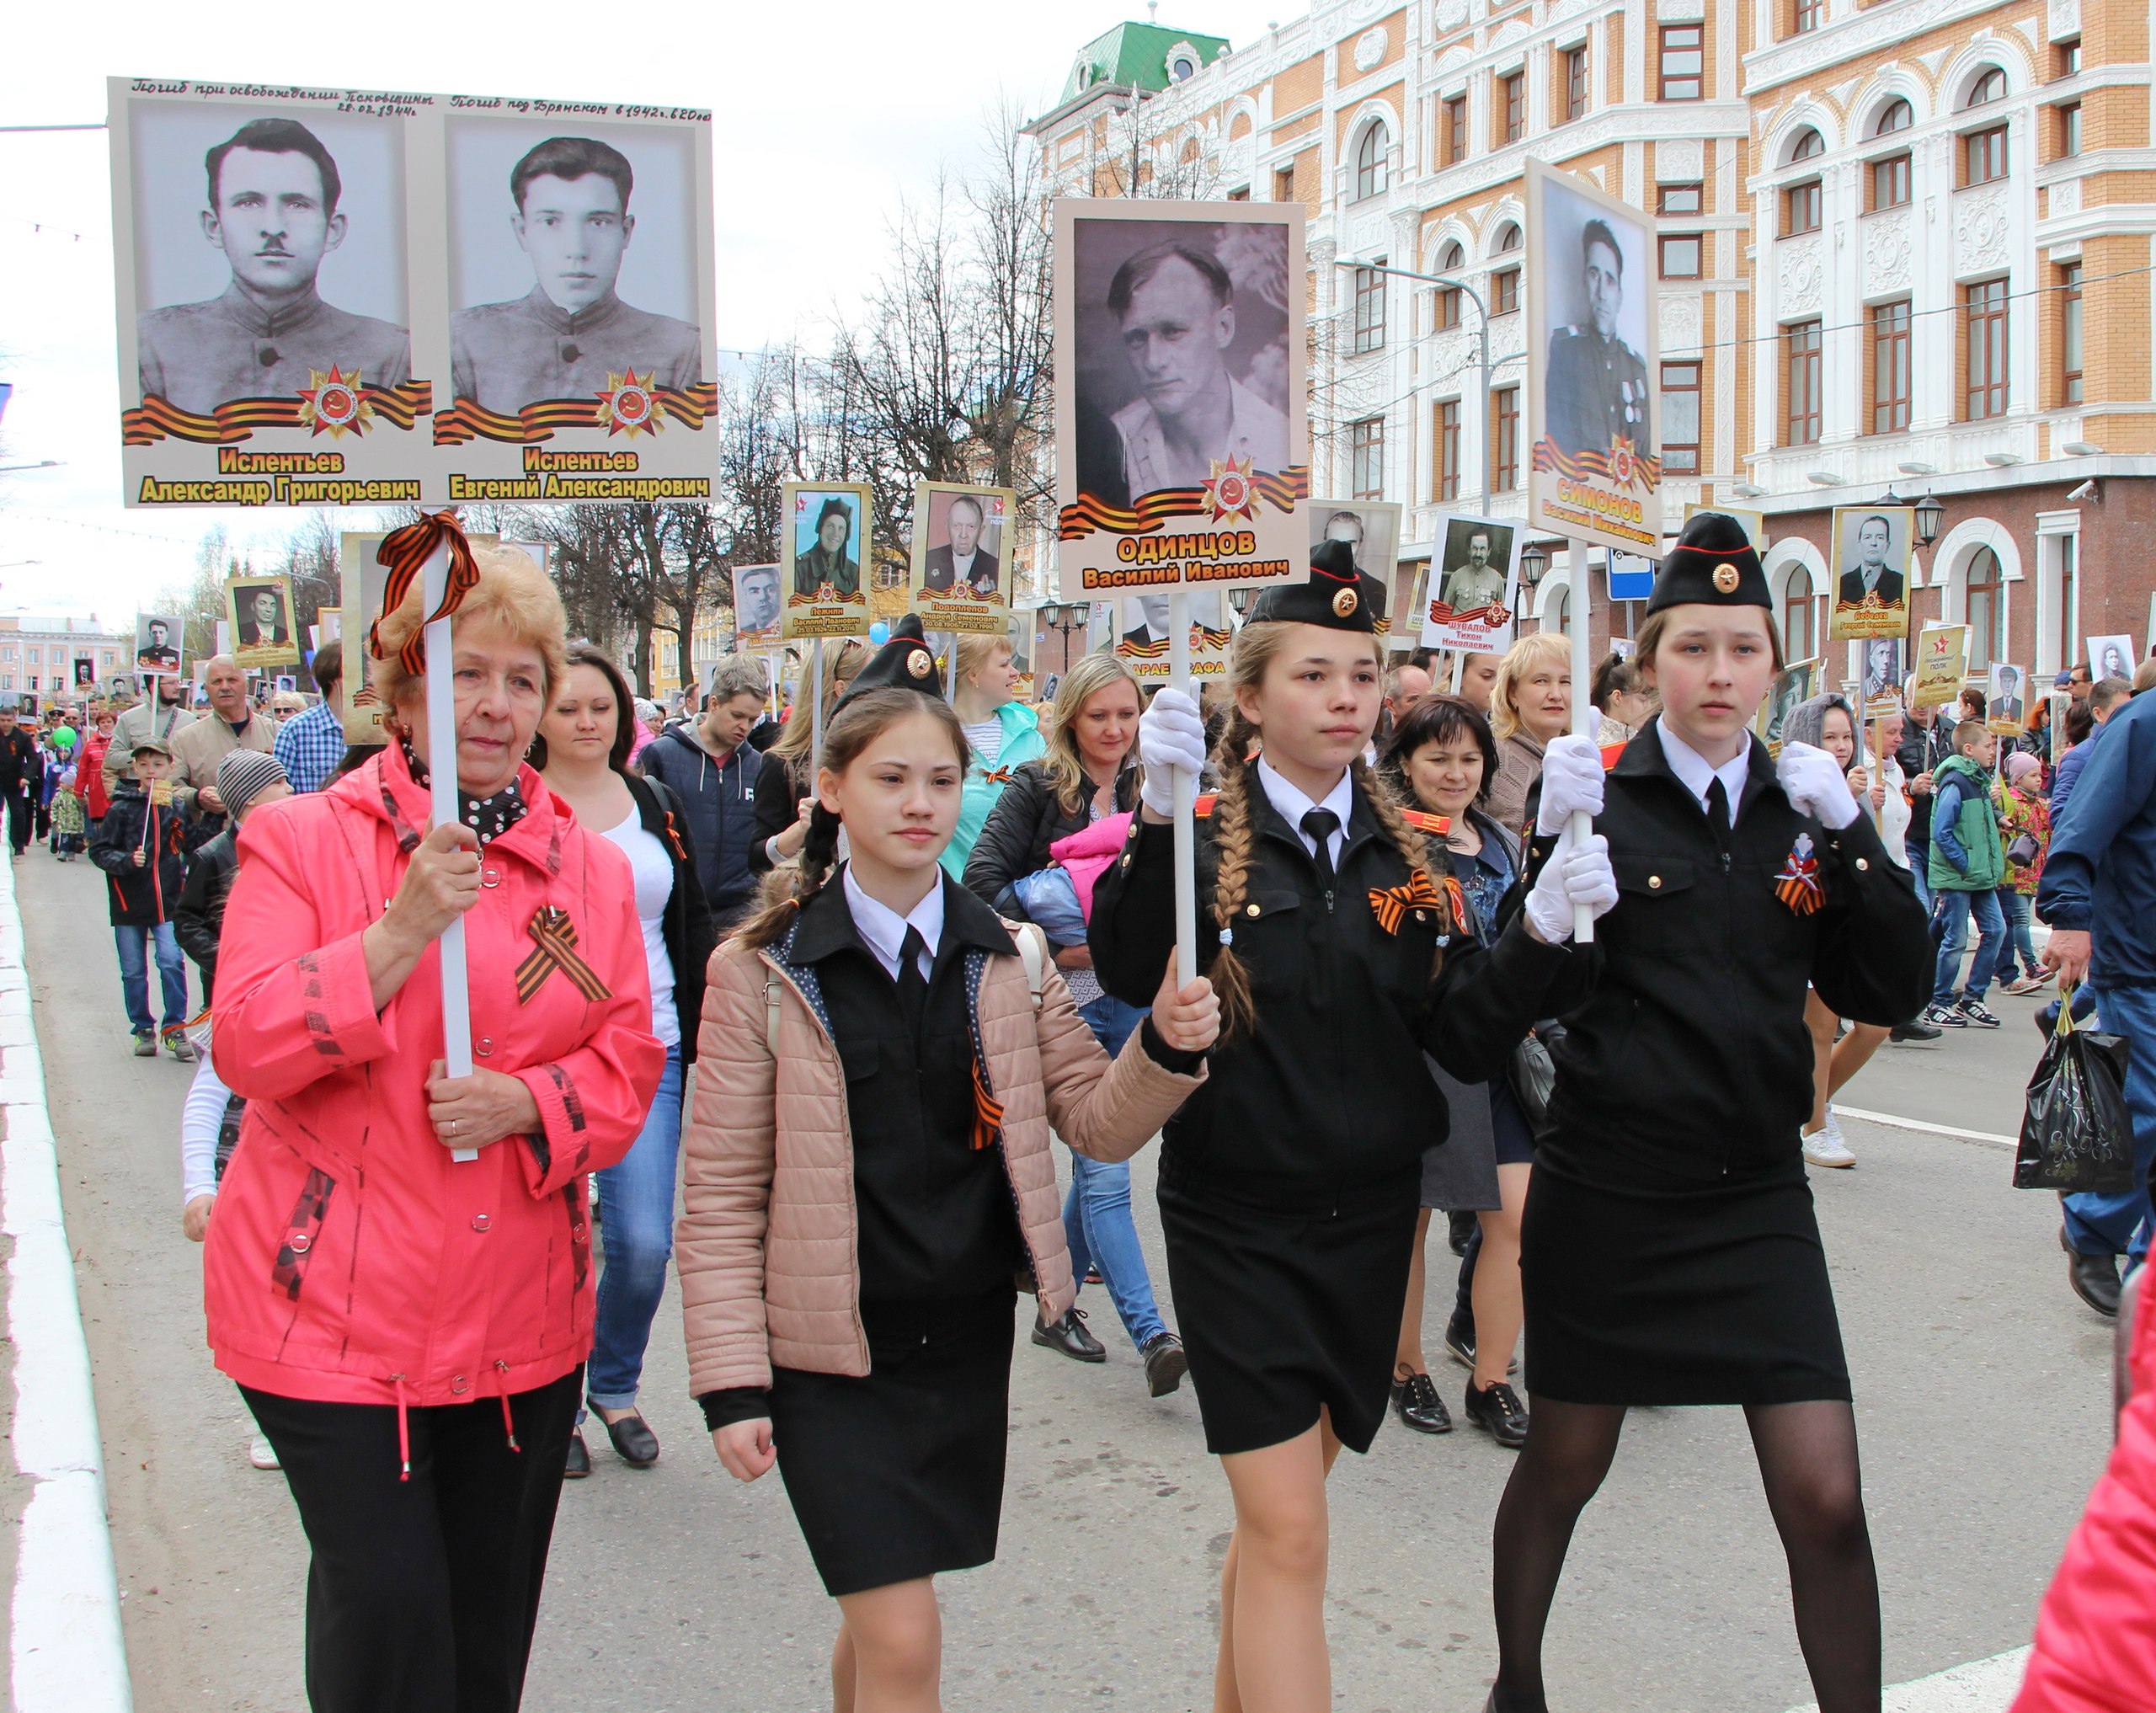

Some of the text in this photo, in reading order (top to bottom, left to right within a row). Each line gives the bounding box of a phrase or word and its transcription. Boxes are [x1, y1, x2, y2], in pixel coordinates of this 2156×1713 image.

[131, 79, 435, 104] Погиб при освобождении Псковщины
[450, 95, 501, 109] Погиб
[507, 100, 530, 113] под
[533, 99, 608, 116] Брянском
[218, 447, 344, 474] Ислентьев
[523, 447, 638, 472] Ислентьев
[139, 476, 421, 505] Александр Григорьевич
[449, 474, 711, 501] Евгений Александрович
[1556, 478, 1642, 524] СИМОНОВ
[1542, 499, 1656, 547] Василий Михайлович
[1117, 531, 1256, 564] ОДИНЦОВ
[1082, 559, 1289, 588] Василий Иванович
[793, 616, 860, 627] Василий Иванович
[810, 607, 844, 616] Лежнин
[921, 612, 999, 622] Андрей Семенович
[1854, 610, 1888, 621] Лебедев
[1448, 621, 1492, 632] ШУВАЛОВ
[1455, 631, 1482, 641] Тихон
[1442, 638, 1493, 650] Николаевич
[1929, 662, 1947, 670] ПОЛК
